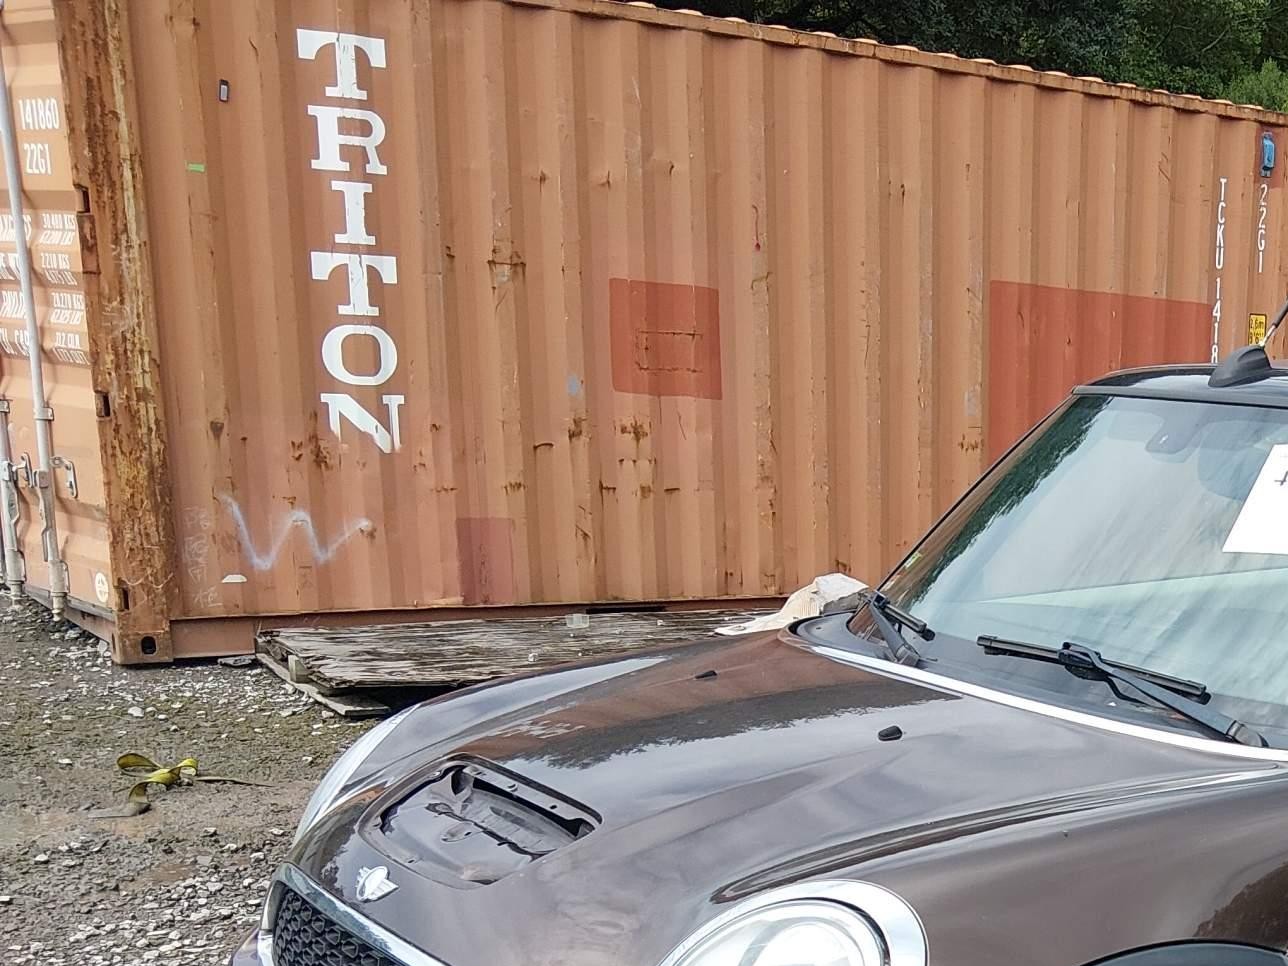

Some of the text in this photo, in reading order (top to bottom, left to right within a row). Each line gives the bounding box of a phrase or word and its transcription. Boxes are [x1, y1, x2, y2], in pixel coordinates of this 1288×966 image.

[18, 97, 60, 130] 141860
[23, 143, 52, 175] 22G1
[296, 28, 405, 455] TRITON
[1214, 178, 1228, 270] TCKU
[1257, 184, 1268, 273] 22G1
